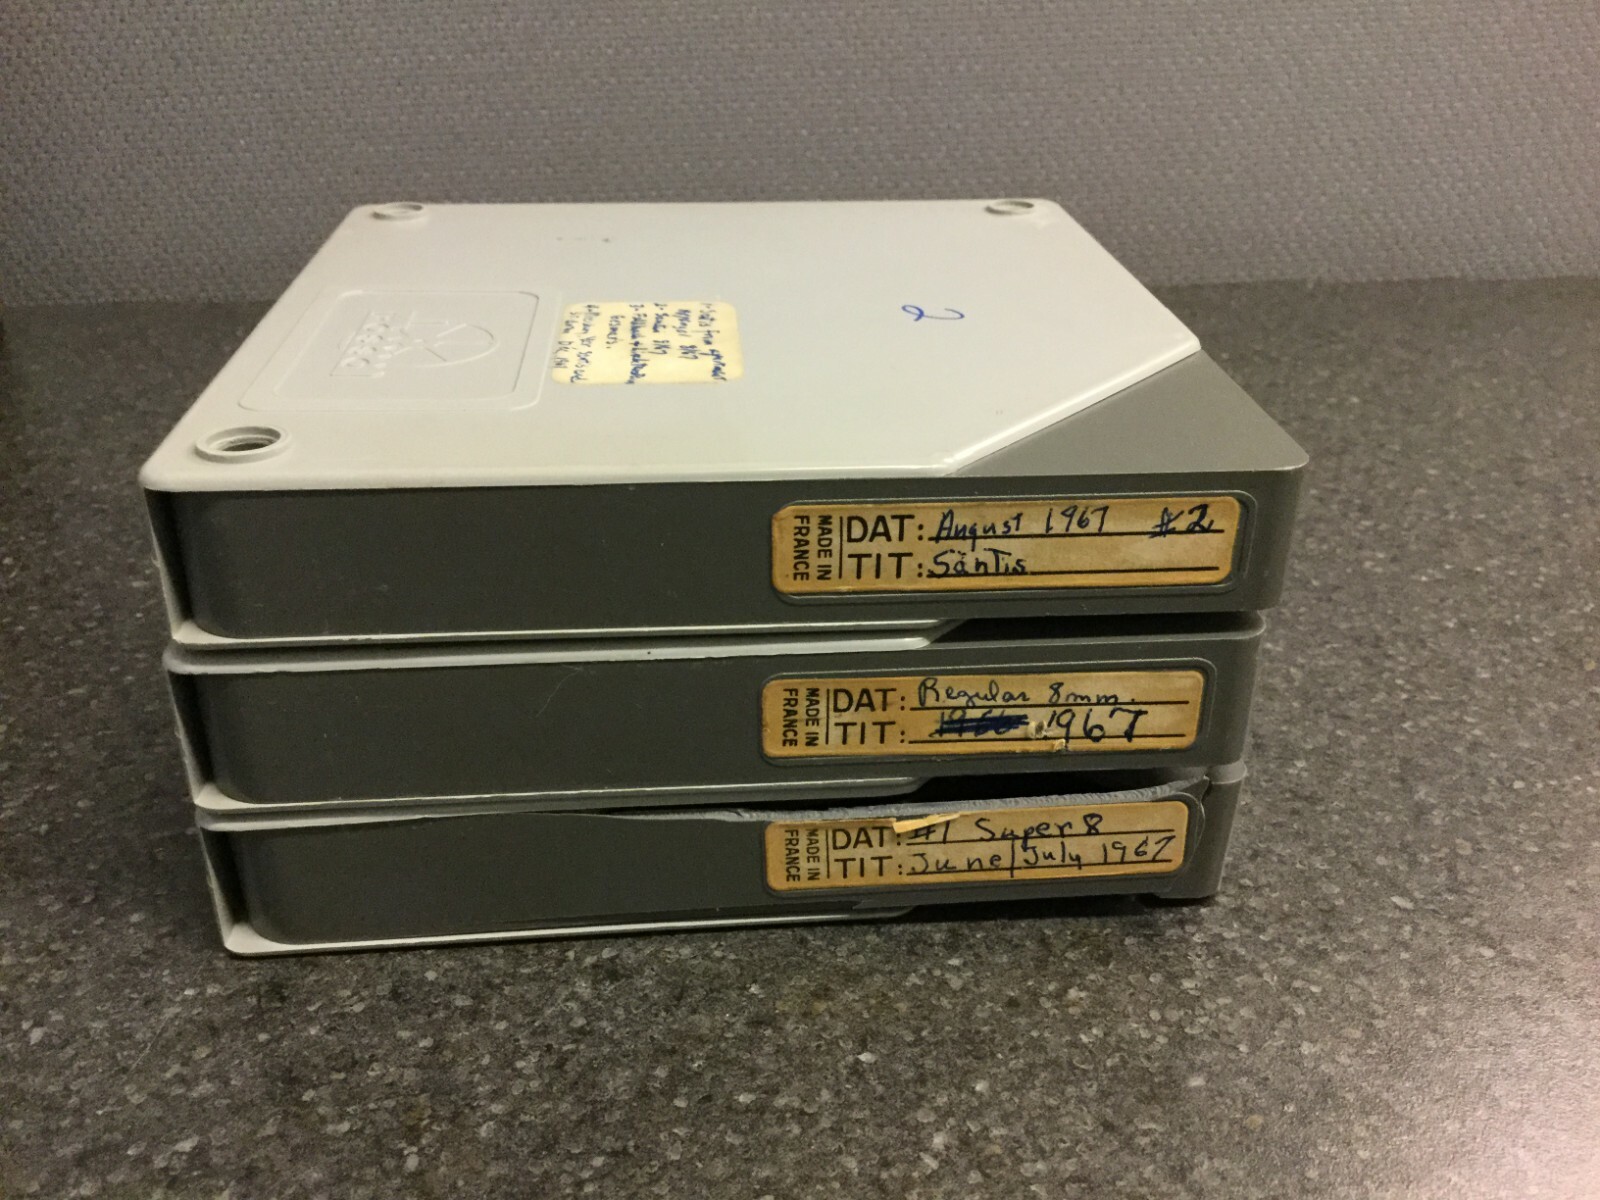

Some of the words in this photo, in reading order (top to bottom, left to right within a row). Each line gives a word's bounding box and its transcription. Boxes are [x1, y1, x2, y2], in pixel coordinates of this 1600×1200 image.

[793, 514, 810, 581] FRANCE
[817, 514, 833, 559] MADE
[847, 514, 925, 542] DAT:
[934, 508, 1024, 552] August
[1045, 505, 1110, 534] 1967
[817, 563, 832, 580] IN
[847, 552, 924, 579] TIT:
[805, 687, 820, 727] MADE
[833, 687, 906, 713] DAT:
[917, 677, 1031, 708] Regular
[782, 688, 799, 747] FRANCE
[834, 721, 906, 745] TIT:
[1047, 707, 1149, 751] 1967
[805, 731, 820, 747] IN
[806, 828, 820, 864] MADE
[832, 826, 902, 850] DAT:
[974, 817, 1073, 849] Super
[1082, 813, 1103, 836] 8
[784, 829, 801, 882] FRANCE
[807, 867, 821, 881] IN
[834, 855, 903, 879] TIT:
[1102, 835, 1177, 865] 1967
